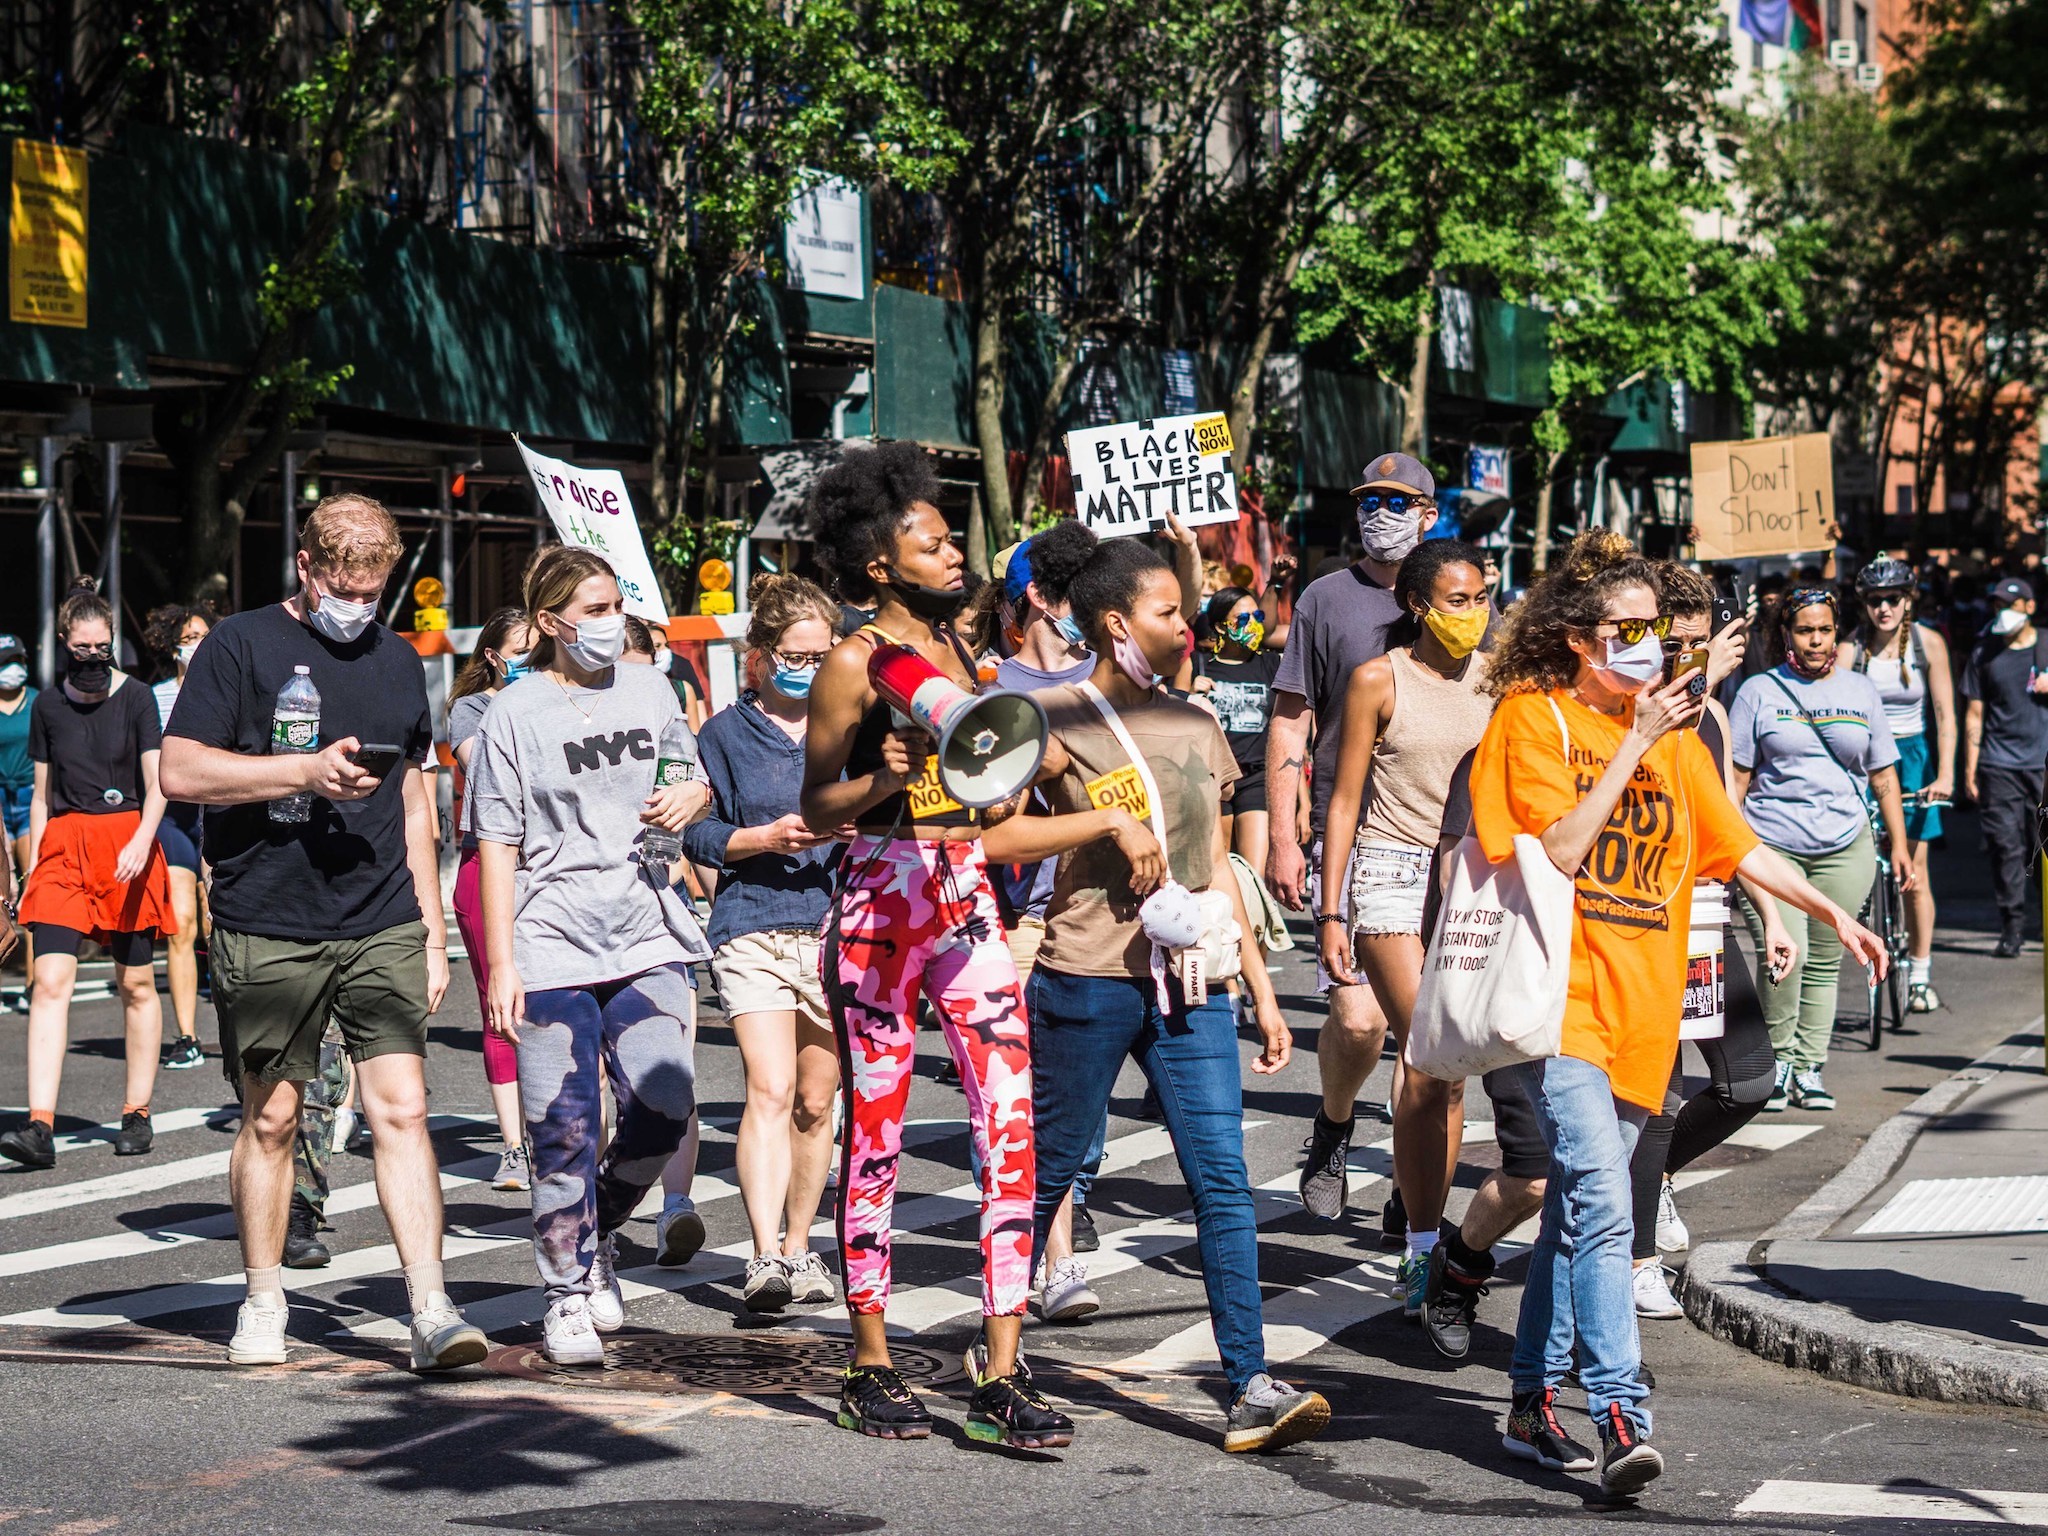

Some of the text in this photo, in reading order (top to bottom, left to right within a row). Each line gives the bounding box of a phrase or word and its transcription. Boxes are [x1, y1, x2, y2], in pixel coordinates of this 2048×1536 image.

[1095, 428, 1200, 464] BLACK
[1199, 424, 1223, 440] OUT
[1199, 435, 1230, 453] NOW
[1103, 455, 1201, 484] LIVES
[1086, 471, 1233, 528] MATTER
[569, 514, 610, 553] the
[562, 728, 655, 775] NYC
[912, 789, 949, 809] NO
[1098, 777, 1137, 806] OUT
[1575, 831, 1669, 897] OW!
[1474, 909, 1507, 926] STORE
[1444, 931, 1491, 949] STANTON
[1443, 955, 1456, 970] NY
[1459, 955, 1489, 971] 10002
[1190, 961, 1199, 997] IVY PARK
